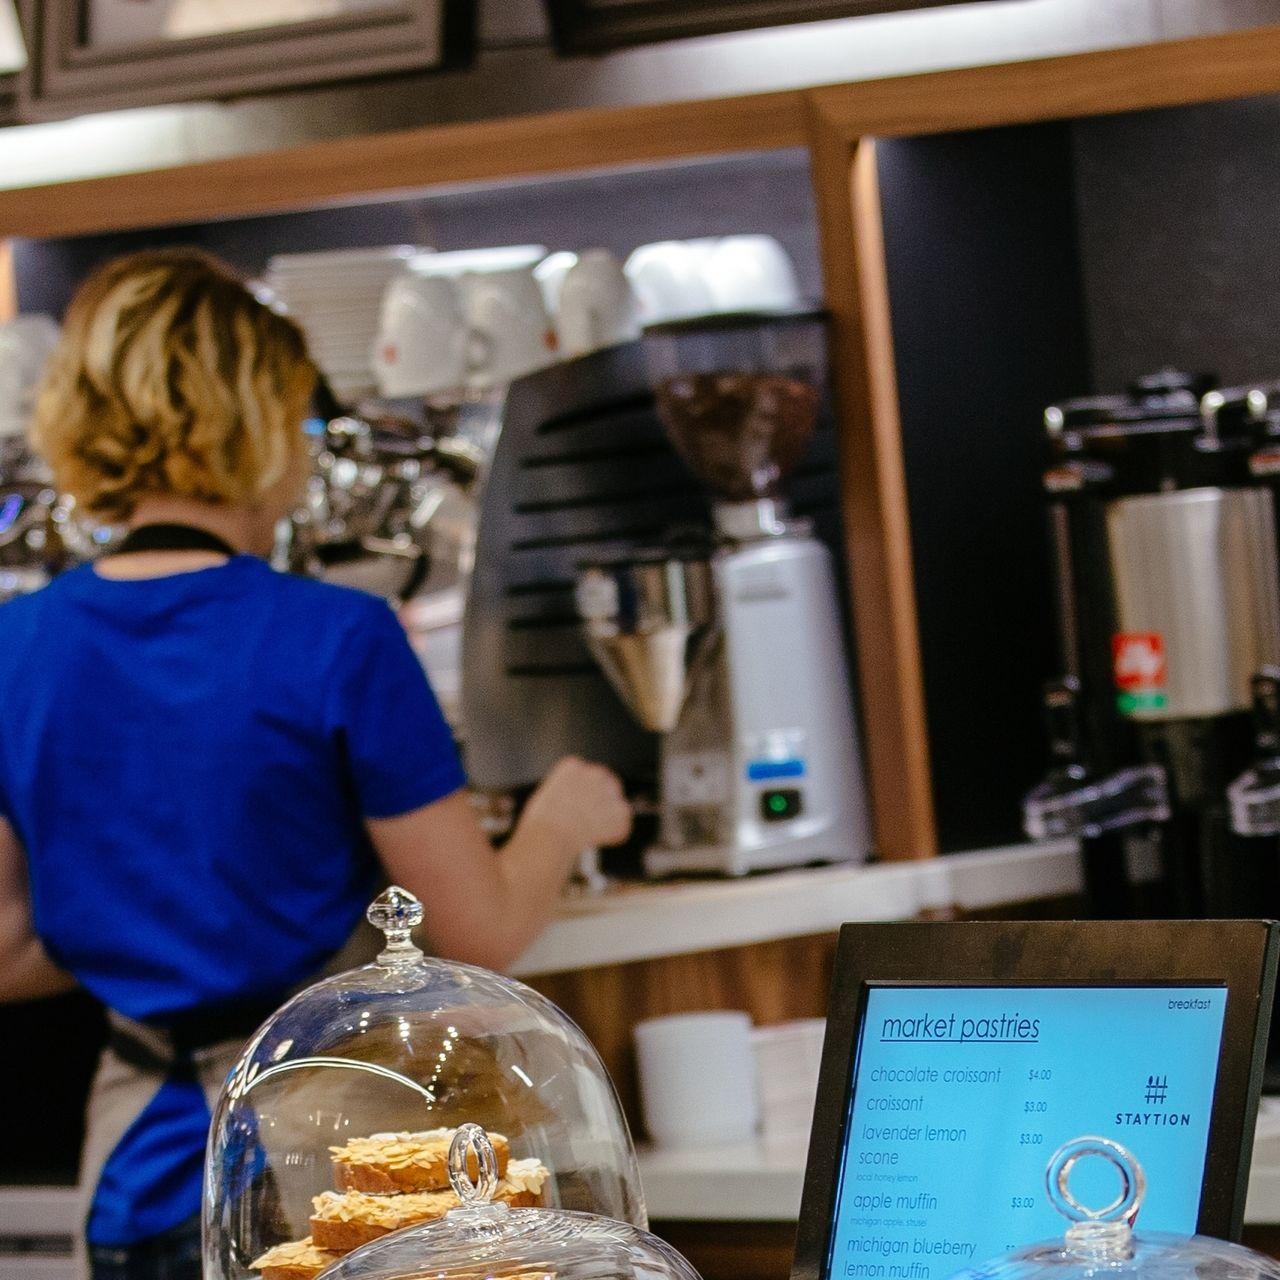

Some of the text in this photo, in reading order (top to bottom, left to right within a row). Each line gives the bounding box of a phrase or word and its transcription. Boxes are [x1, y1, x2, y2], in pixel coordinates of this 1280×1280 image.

[1168, 998, 1211, 1010] breakfast
[882, 1012, 1040, 1043] market pastries
[870, 1066, 1051, 1083] chocolate croissant $4.00
[866, 1095, 1047, 1113] croissant $3.00
[1115, 1113, 1191, 1126] STAYTION
[862, 1124, 1043, 1145] lavender lemon $3.00
[858, 1152, 899, 1165] scone
[853, 1192, 1034, 1211] apple muffin $3.00
[847, 1236, 976, 1258] michigan blueberry
[844, 1261, 930, 1279] lemon muffin
